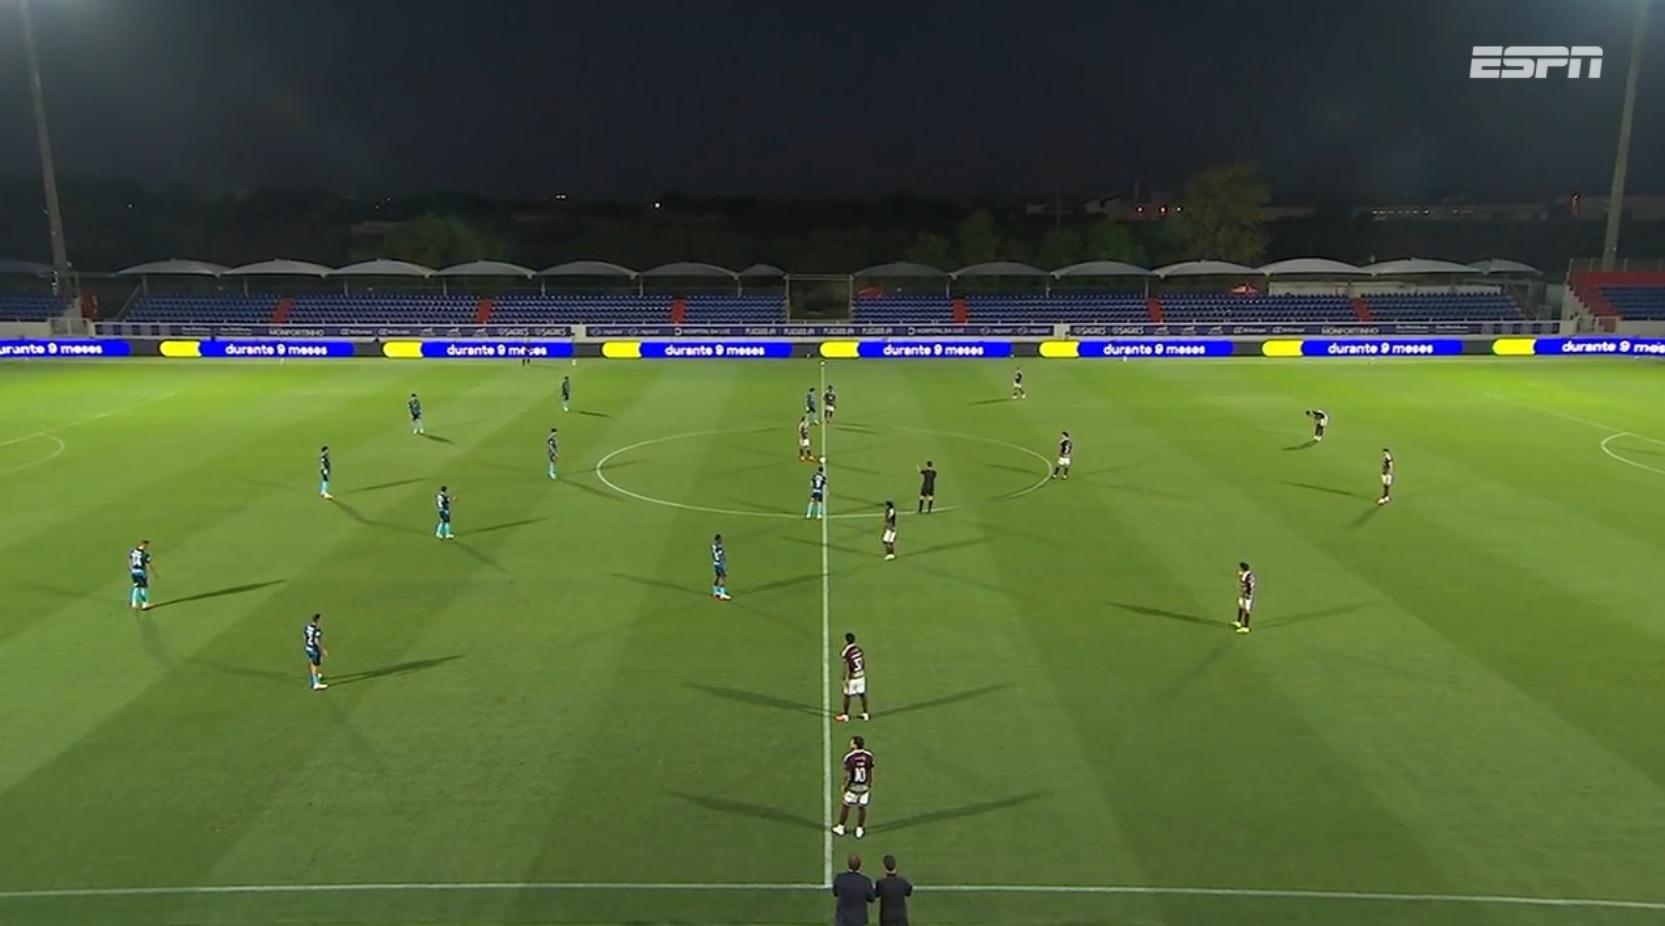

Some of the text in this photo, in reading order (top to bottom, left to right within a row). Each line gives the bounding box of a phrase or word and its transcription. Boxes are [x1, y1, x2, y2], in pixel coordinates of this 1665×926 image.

[48, 343, 57, 355] 9
[60, 345, 102, 354] meses
[225, 344, 328, 355] durante 9 meses
[447, 344, 495, 356] durante
[497, 344, 506, 355] 9
[665, 343, 765, 355] durante 9 meses
[883, 344, 984, 355] durante 9 meses
[1104, 343, 1205, 355] durante 9 meses
[1328, 343, 1433, 354] durante 9 meses
[1562, 341, 1616, 352] durante
[1619, 341, 1630, 352] 9
[854, 767, 866, 783] 10
